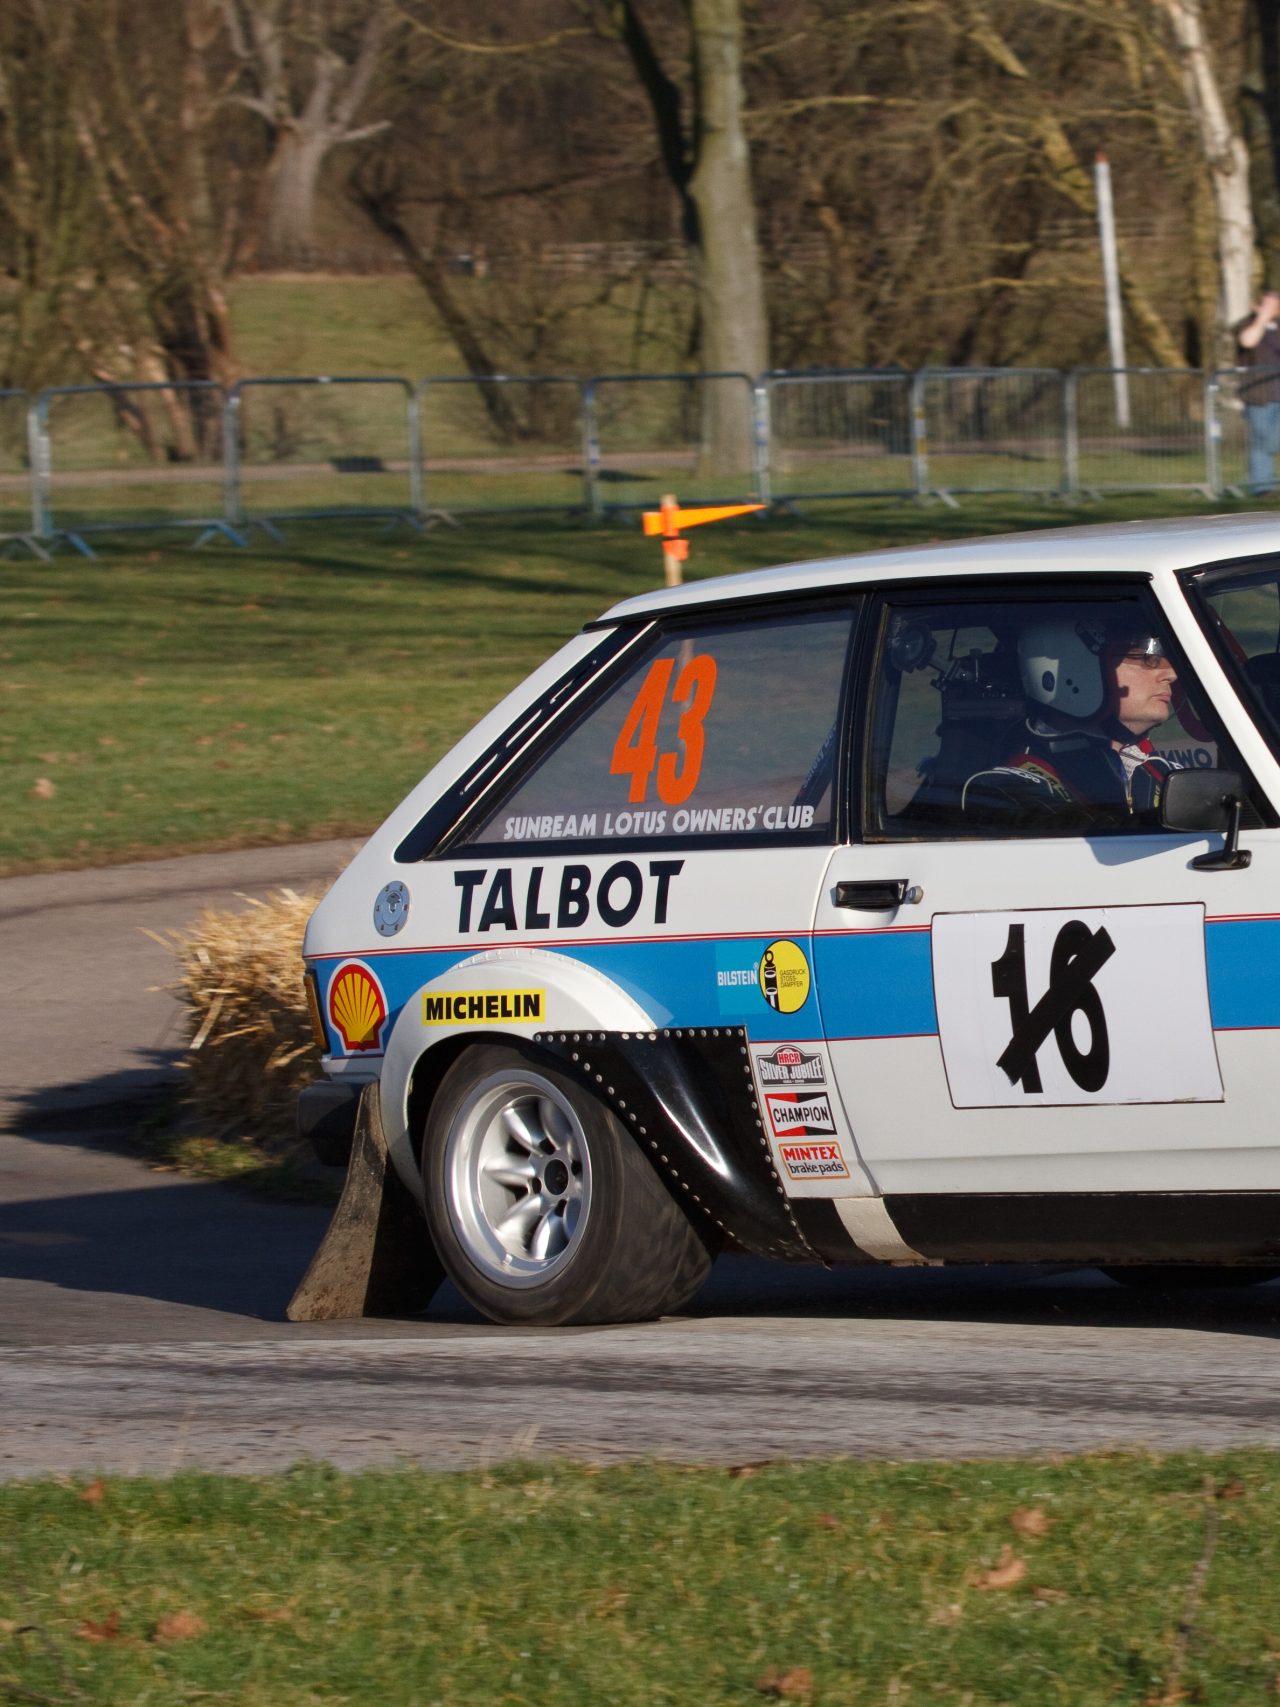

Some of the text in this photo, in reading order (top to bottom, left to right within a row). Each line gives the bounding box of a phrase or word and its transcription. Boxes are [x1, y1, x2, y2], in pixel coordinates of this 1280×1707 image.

[609, 654, 718, 805] 43
[504, 811, 597, 839] SUNBEAM
[604, 809, 666, 836] LOTUS
[454, 860, 685, 933] TALBOT
[717, 970, 758, 986] BILSTEIN
[426, 994, 540, 1020] MICHELIN
[760, 1057, 823, 1080] SILVER JUBILEE
[773, 1105, 830, 1123] CHAMPION
[783, 1146, 839, 1160] MINTEX
[788, 1162, 845, 1175] brake pads
